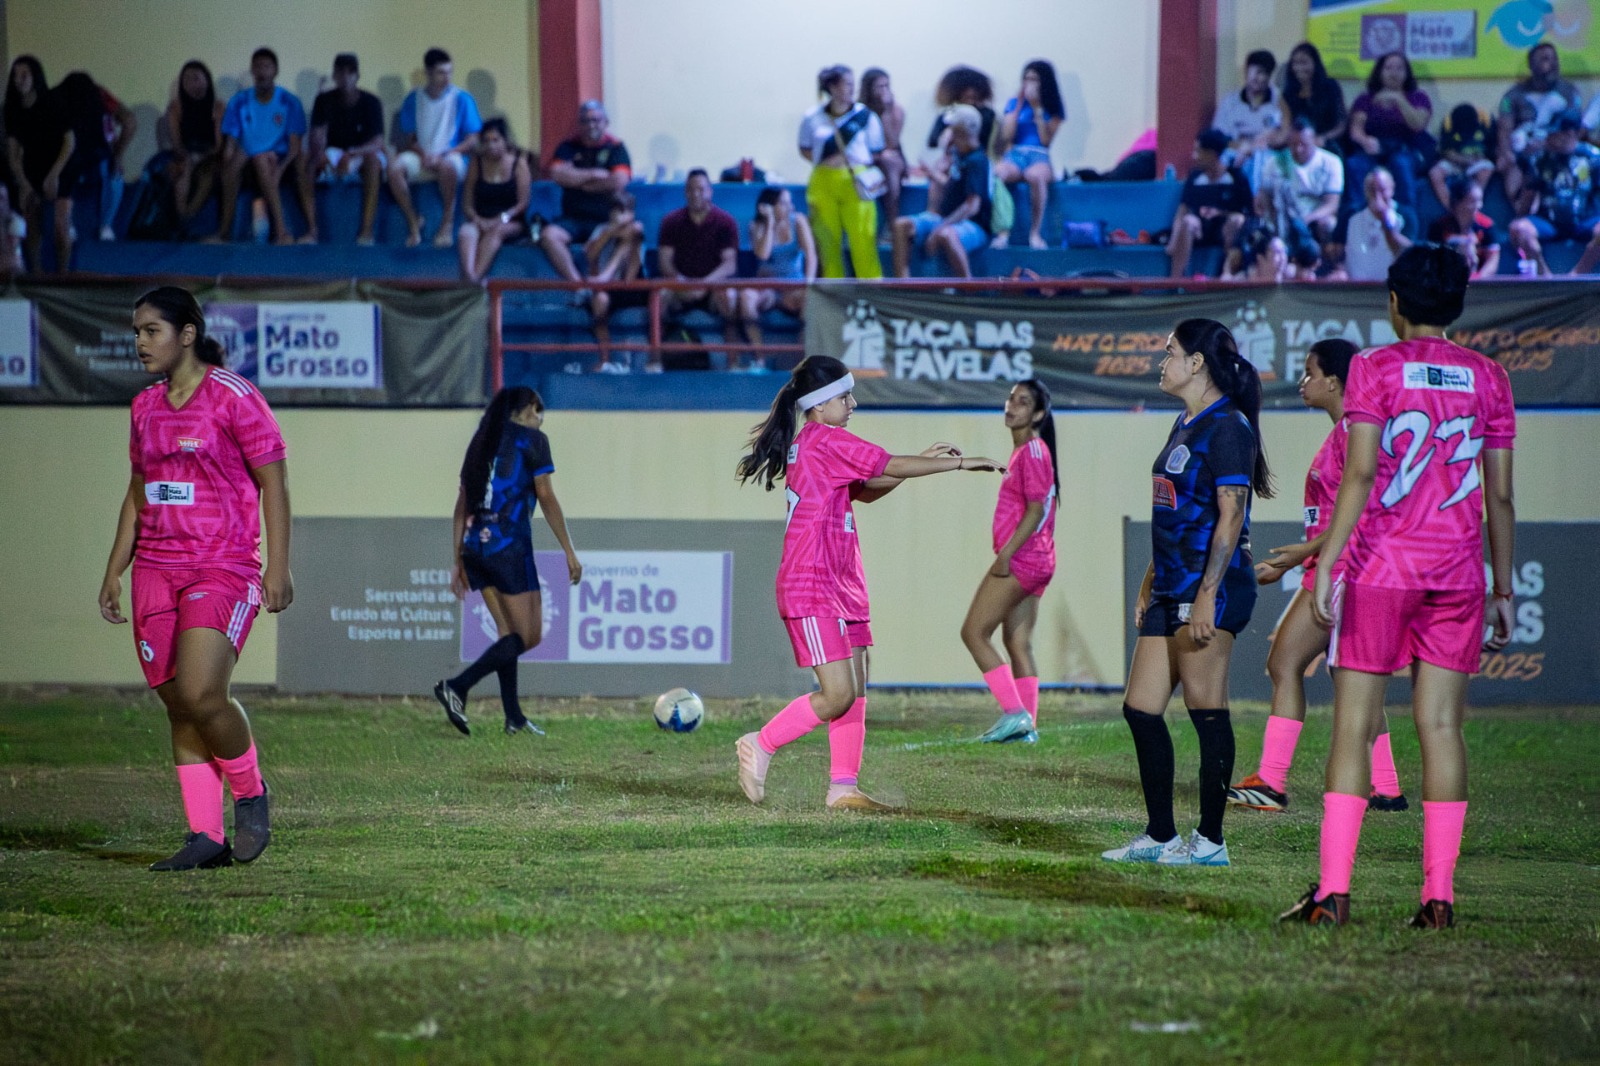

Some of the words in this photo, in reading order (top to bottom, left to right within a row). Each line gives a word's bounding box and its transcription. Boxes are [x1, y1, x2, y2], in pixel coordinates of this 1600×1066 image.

[265, 325, 339, 349] Mato
[975, 320, 1035, 349] DAS
[265, 351, 369, 376] Grosso
[895, 348, 1034, 380] FAVELAS
[1379, 409, 1485, 511] 23
[641, 563, 660, 577] de
[578, 579, 678, 614] Mato
[330, 605, 379, 621] Estado
[380, 606, 398, 621] de
[348, 624, 402, 642] Esporte
[415, 625, 455, 641] Lazer
[577, 616, 715, 651] Grosso
